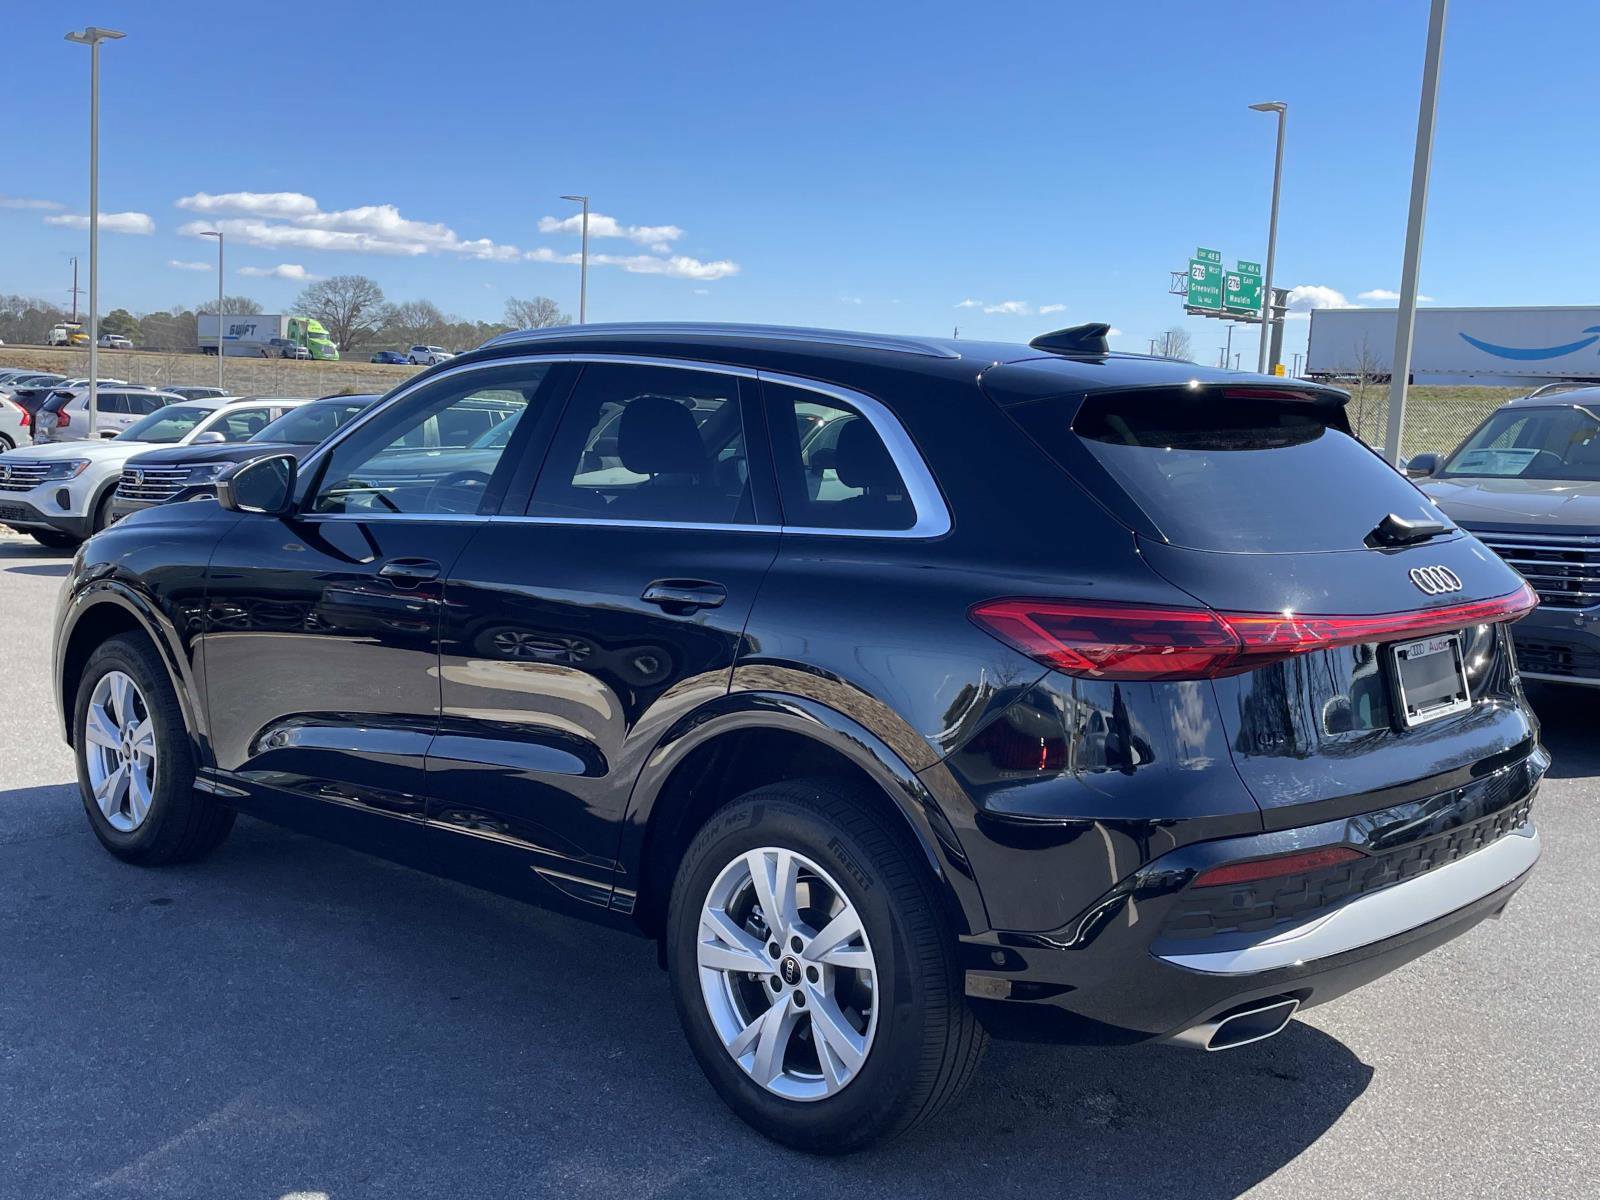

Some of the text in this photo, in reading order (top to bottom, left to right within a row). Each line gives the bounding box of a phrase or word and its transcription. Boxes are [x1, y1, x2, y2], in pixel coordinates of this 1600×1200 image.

[1193, 267, 1205, 278] 276
[1228, 279, 1240, 288] 276
[229, 321, 256, 336] SWIFT
[827, 836, 874, 891] PIRELLI
